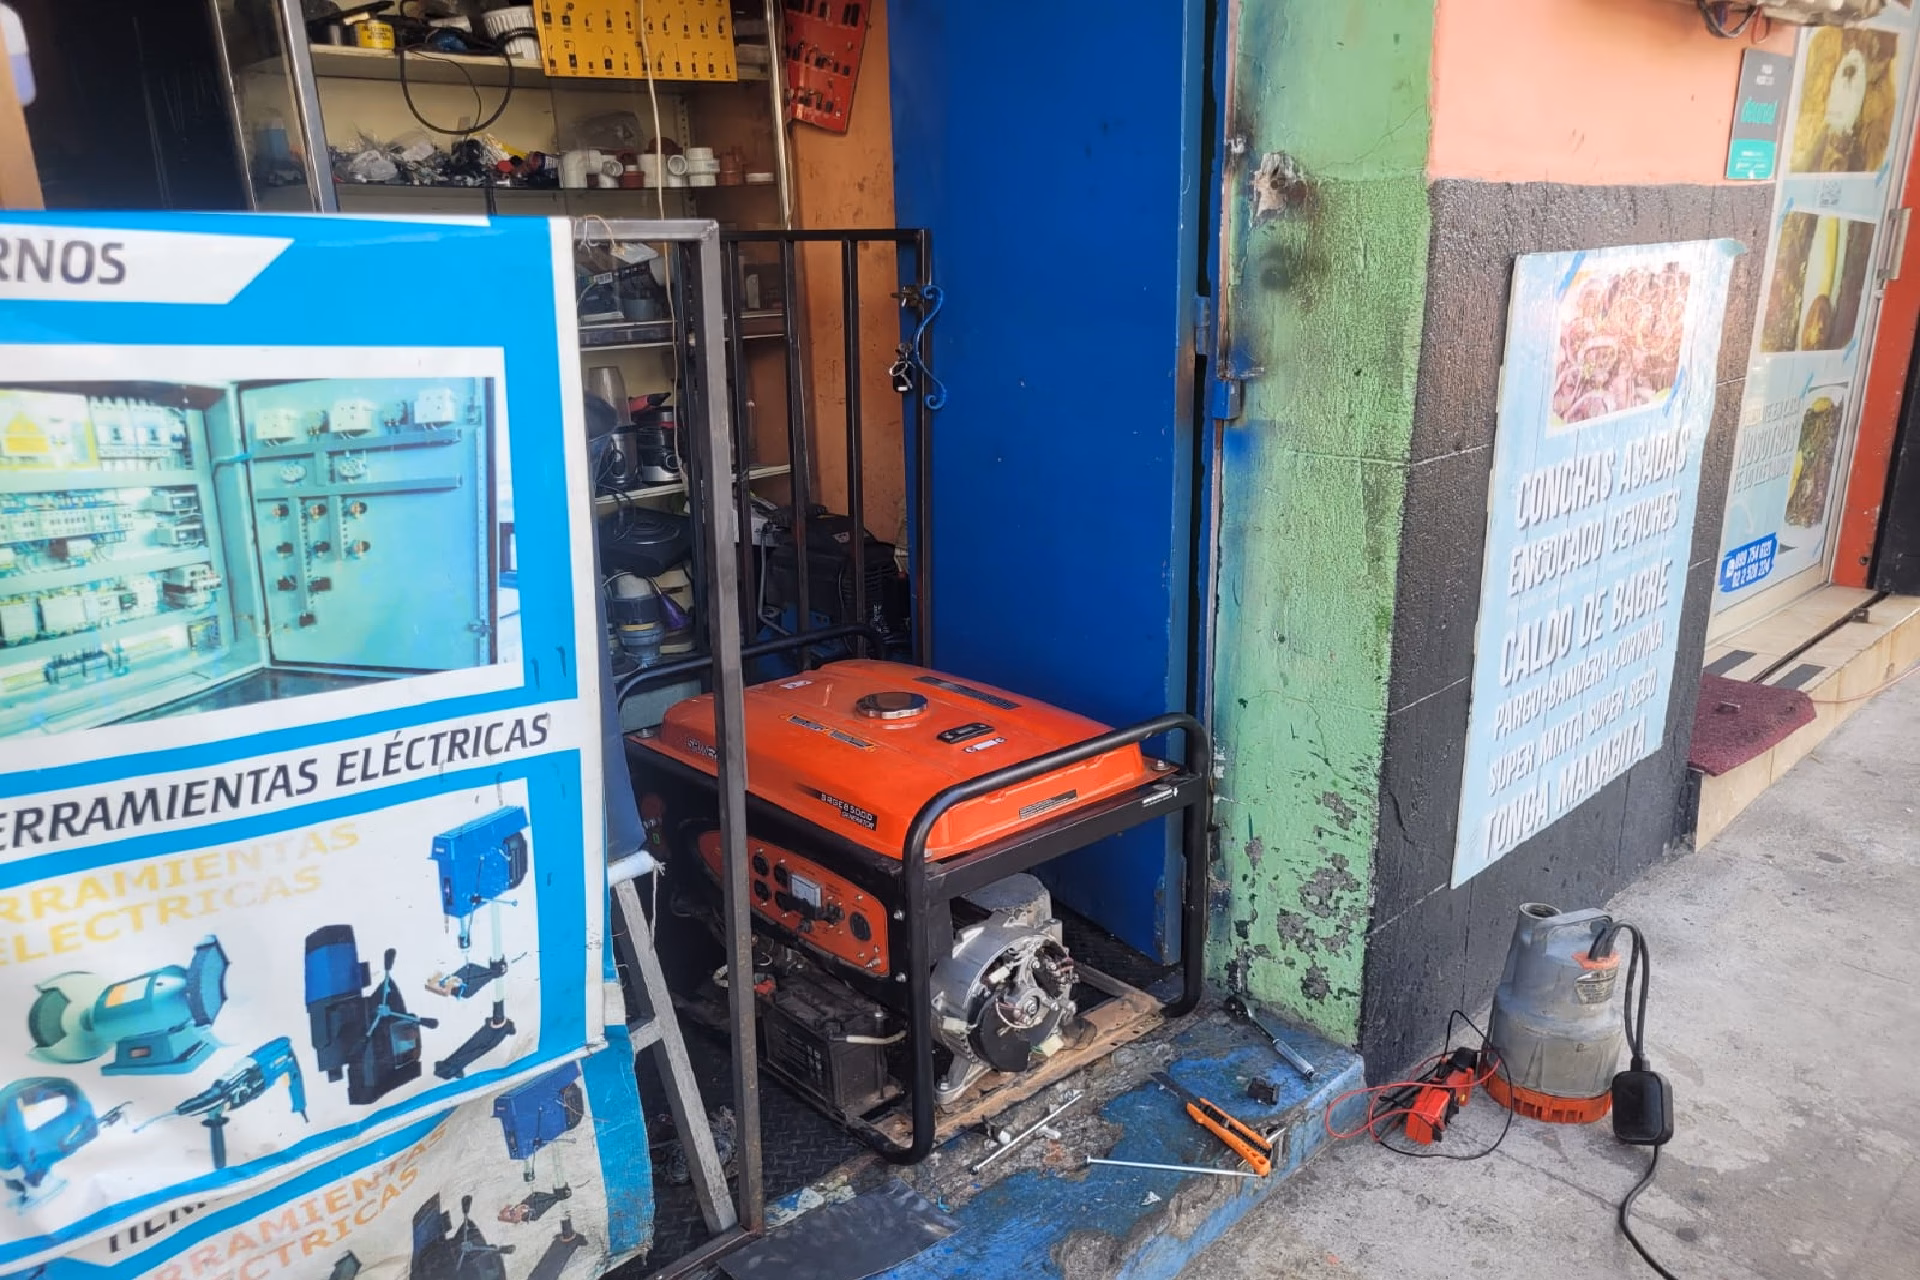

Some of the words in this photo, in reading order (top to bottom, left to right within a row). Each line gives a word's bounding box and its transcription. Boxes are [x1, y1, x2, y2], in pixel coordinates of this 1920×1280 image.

[0, 238, 127, 285] NOS
[1515, 451, 1615, 530] CONCHAS
[1610, 489, 1681, 553] CEVICHES
[1499, 603, 1574, 686] CALDO
[1578, 586, 1608, 648] DE
[1610, 558, 1672, 632] BAGRE
[336, 712, 551, 787] ELÉCTRICAS
[1489, 740, 1536, 797] SUPER
[1539, 710, 1584, 767] MIXTA
[1589, 686, 1626, 736] SUPER
[1485, 780, 1550, 859] TONGA
